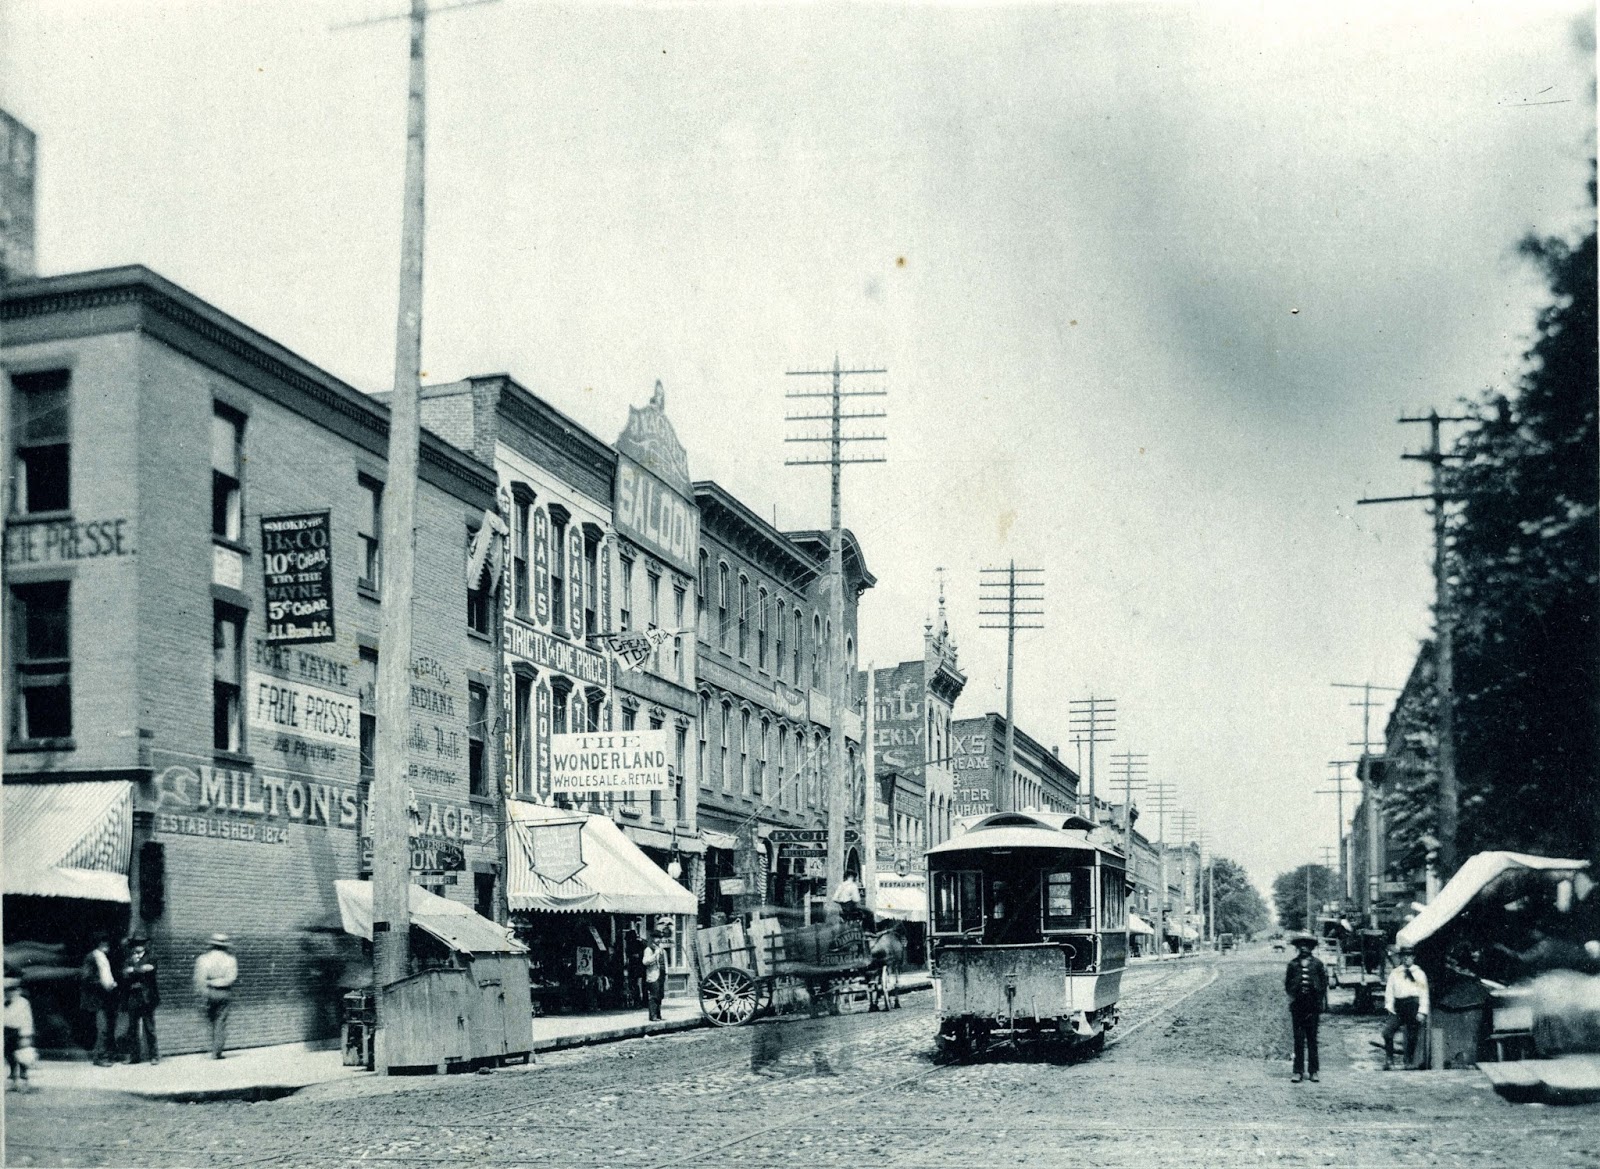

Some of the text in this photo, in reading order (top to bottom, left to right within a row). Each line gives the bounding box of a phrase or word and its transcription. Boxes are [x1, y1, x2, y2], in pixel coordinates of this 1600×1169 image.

[617, 464, 699, 569] SALOON
[536, 515, 547, 616] HATS
[570, 535, 581, 631] CAPS
[503, 620, 552, 666] STRICTLY
[556, 641, 576, 674] ONE
[257, 682, 299, 728] FREIE
[409, 684, 455, 716] NDIANA
[503, 672, 513, 794] SHIRTS
[539, 691, 549, 793] HOSE
[576, 735, 641, 750] THE
[953, 734, 987, 755] X'S
[553, 750, 665, 772] WONDERLAND
[553, 774, 619, 788] WHOLESALE
[628, 772, 664, 786] RETAIL
[951, 756, 990, 770] REAM
[199, 764, 358, 826] MILTON'S
[160, 814, 256, 842] ESTABLISHED
[879, 881, 926, 889] RESTAURANT
